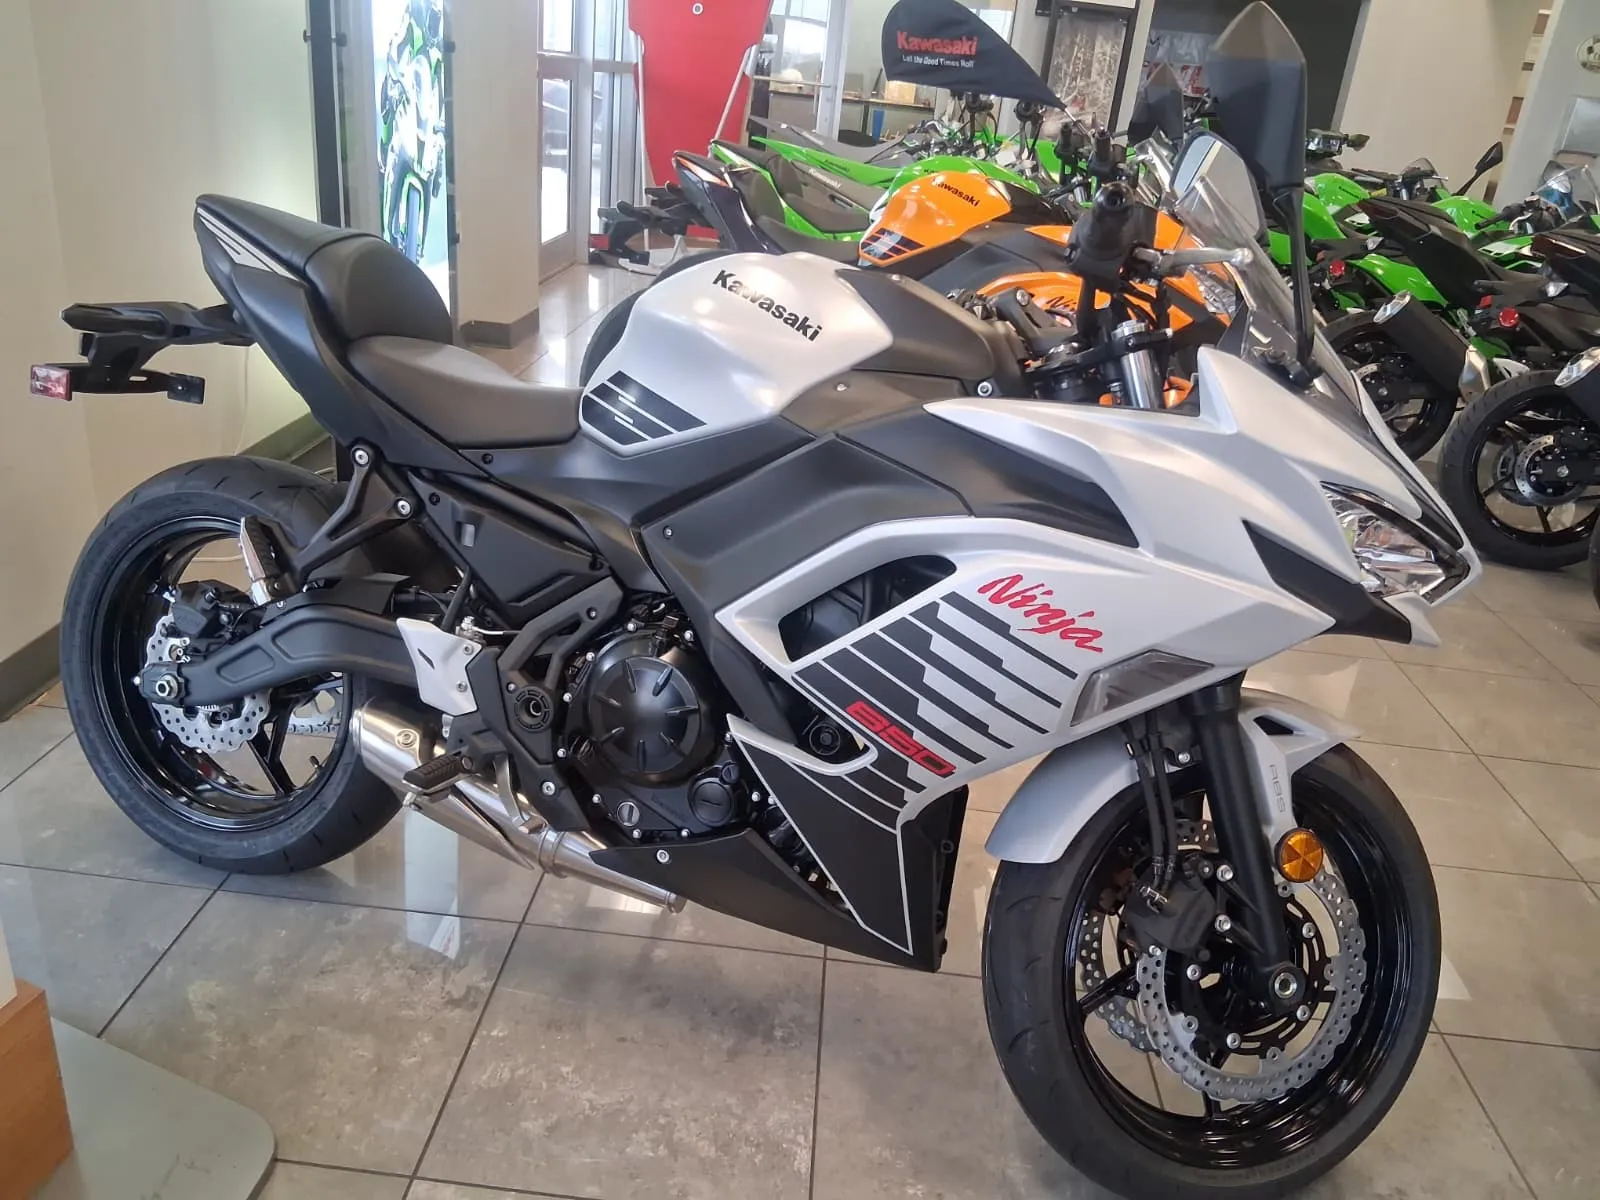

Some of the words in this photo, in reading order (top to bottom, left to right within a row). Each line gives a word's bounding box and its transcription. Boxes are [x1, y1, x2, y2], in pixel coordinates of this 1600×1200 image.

[896, 30, 979, 55] Kawasaki
[923, 56, 939, 66] Good
[939, 57, 960, 67] Times
[932, 176, 981, 207] awasaki
[712, 269, 823, 342] Kawasaki
[977, 574, 1104, 653] Ninja
[845, 699, 957, 777] 650
[1269, 763, 1286, 813] ABS
